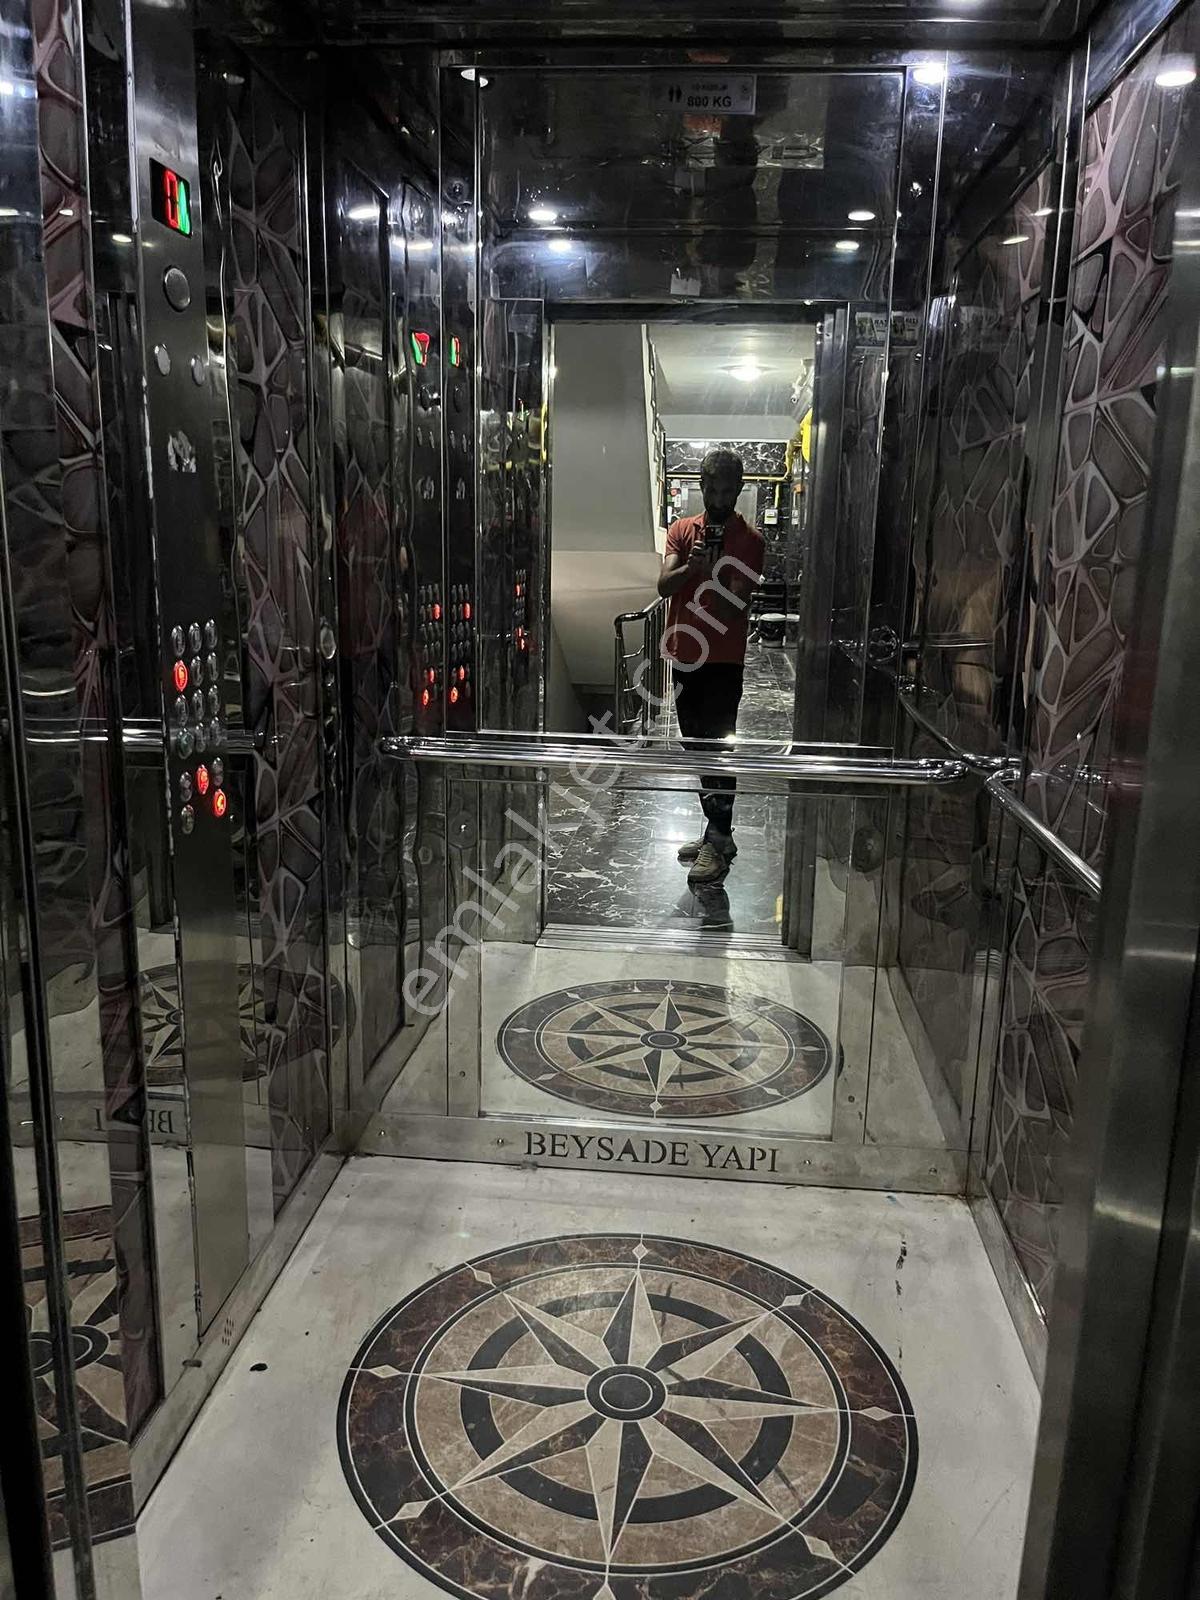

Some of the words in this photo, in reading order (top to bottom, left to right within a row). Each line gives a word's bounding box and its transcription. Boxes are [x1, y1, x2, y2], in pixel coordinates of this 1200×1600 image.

[687, 96, 708, 107] 800
[713, 96, 731, 107] KG
[524, 1131, 689, 1166] BEYSADE
[699, 1143, 779, 1173] YAPI
